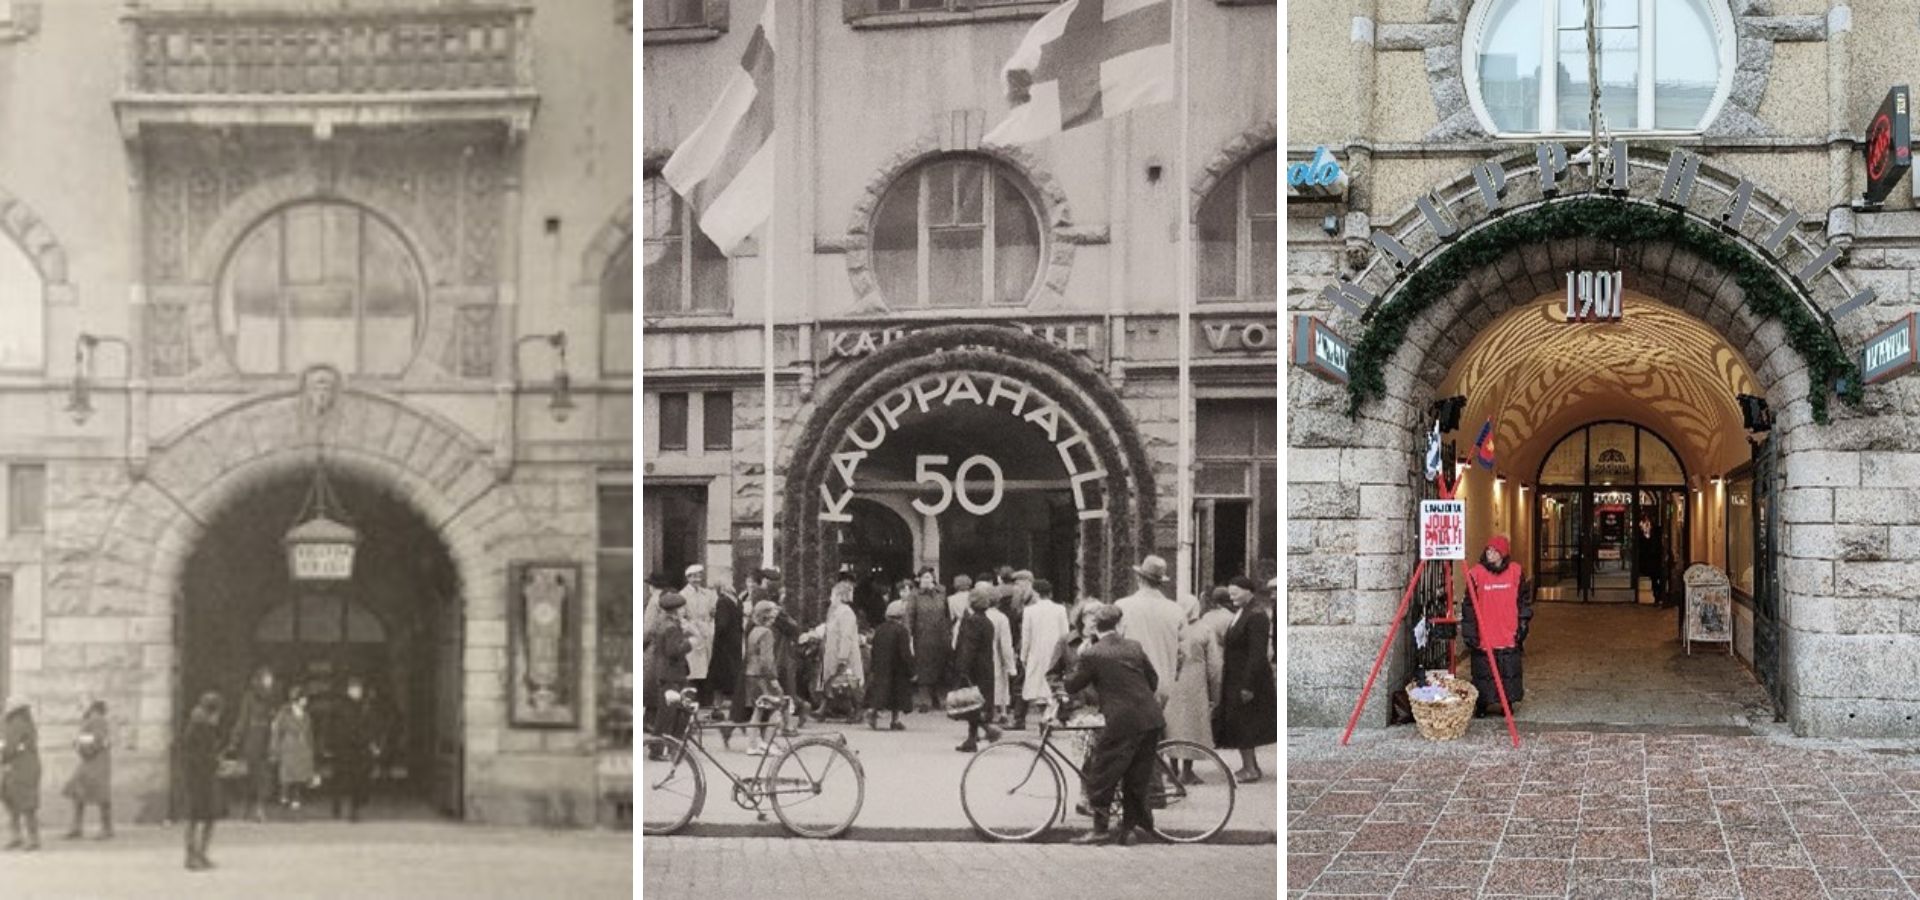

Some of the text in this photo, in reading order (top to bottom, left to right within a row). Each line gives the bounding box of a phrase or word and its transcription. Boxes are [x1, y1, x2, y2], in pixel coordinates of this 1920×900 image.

[1324, 140, 1876, 322] KAUPPAHALLI
[1566, 270, 1622, 318] 1901
[819, 373, 1108, 522] KAUPPAHALLI
[911, 454, 1003, 515] 50
